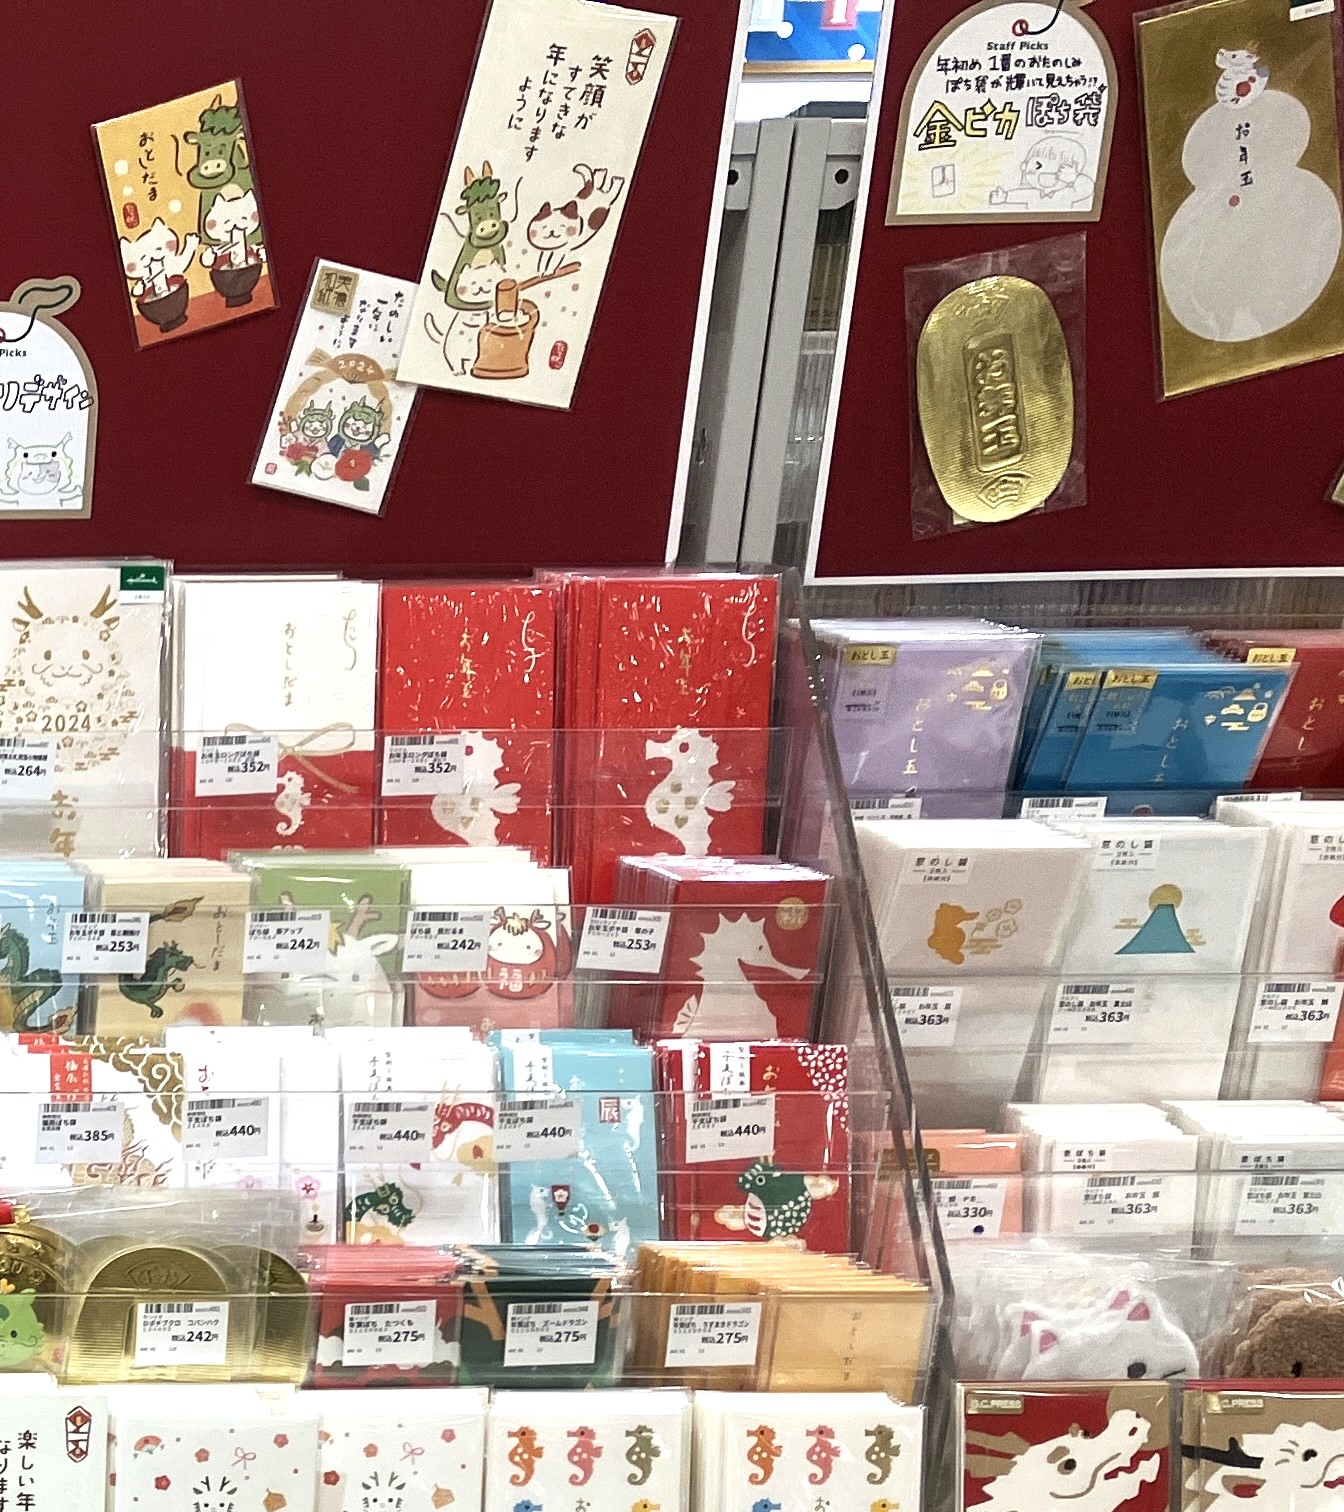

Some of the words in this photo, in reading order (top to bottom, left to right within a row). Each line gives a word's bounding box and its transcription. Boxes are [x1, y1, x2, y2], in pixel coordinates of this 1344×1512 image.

[987, 42, 1015, 50] Staff
[1020, 42, 1048, 50] Picks
[574, 54, 613, 130] 笑顔が
[508, 76, 532, 131] ように
[525, 43, 567, 162] 年になります
[552, 65, 582, 139] すてきな
[1234, 121, 1255, 187] お年玉
[139, 131, 158, 201] おとしだま
[0, 349, 26, 357] Picks
[850, 649, 892, 662] おとし玉
[41, 713, 92, 733] 2024
[415, 761, 457, 774] 税込352円
[437, 938, 481, 951] 税込242円
[1085, 1010, 1129, 1023] 税込363円
[379, 1130, 426, 1141] 税込440円
[1111, 1203, 1157, 1215] 税込363円
[172, 1331, 218, 1342] 税込242円
